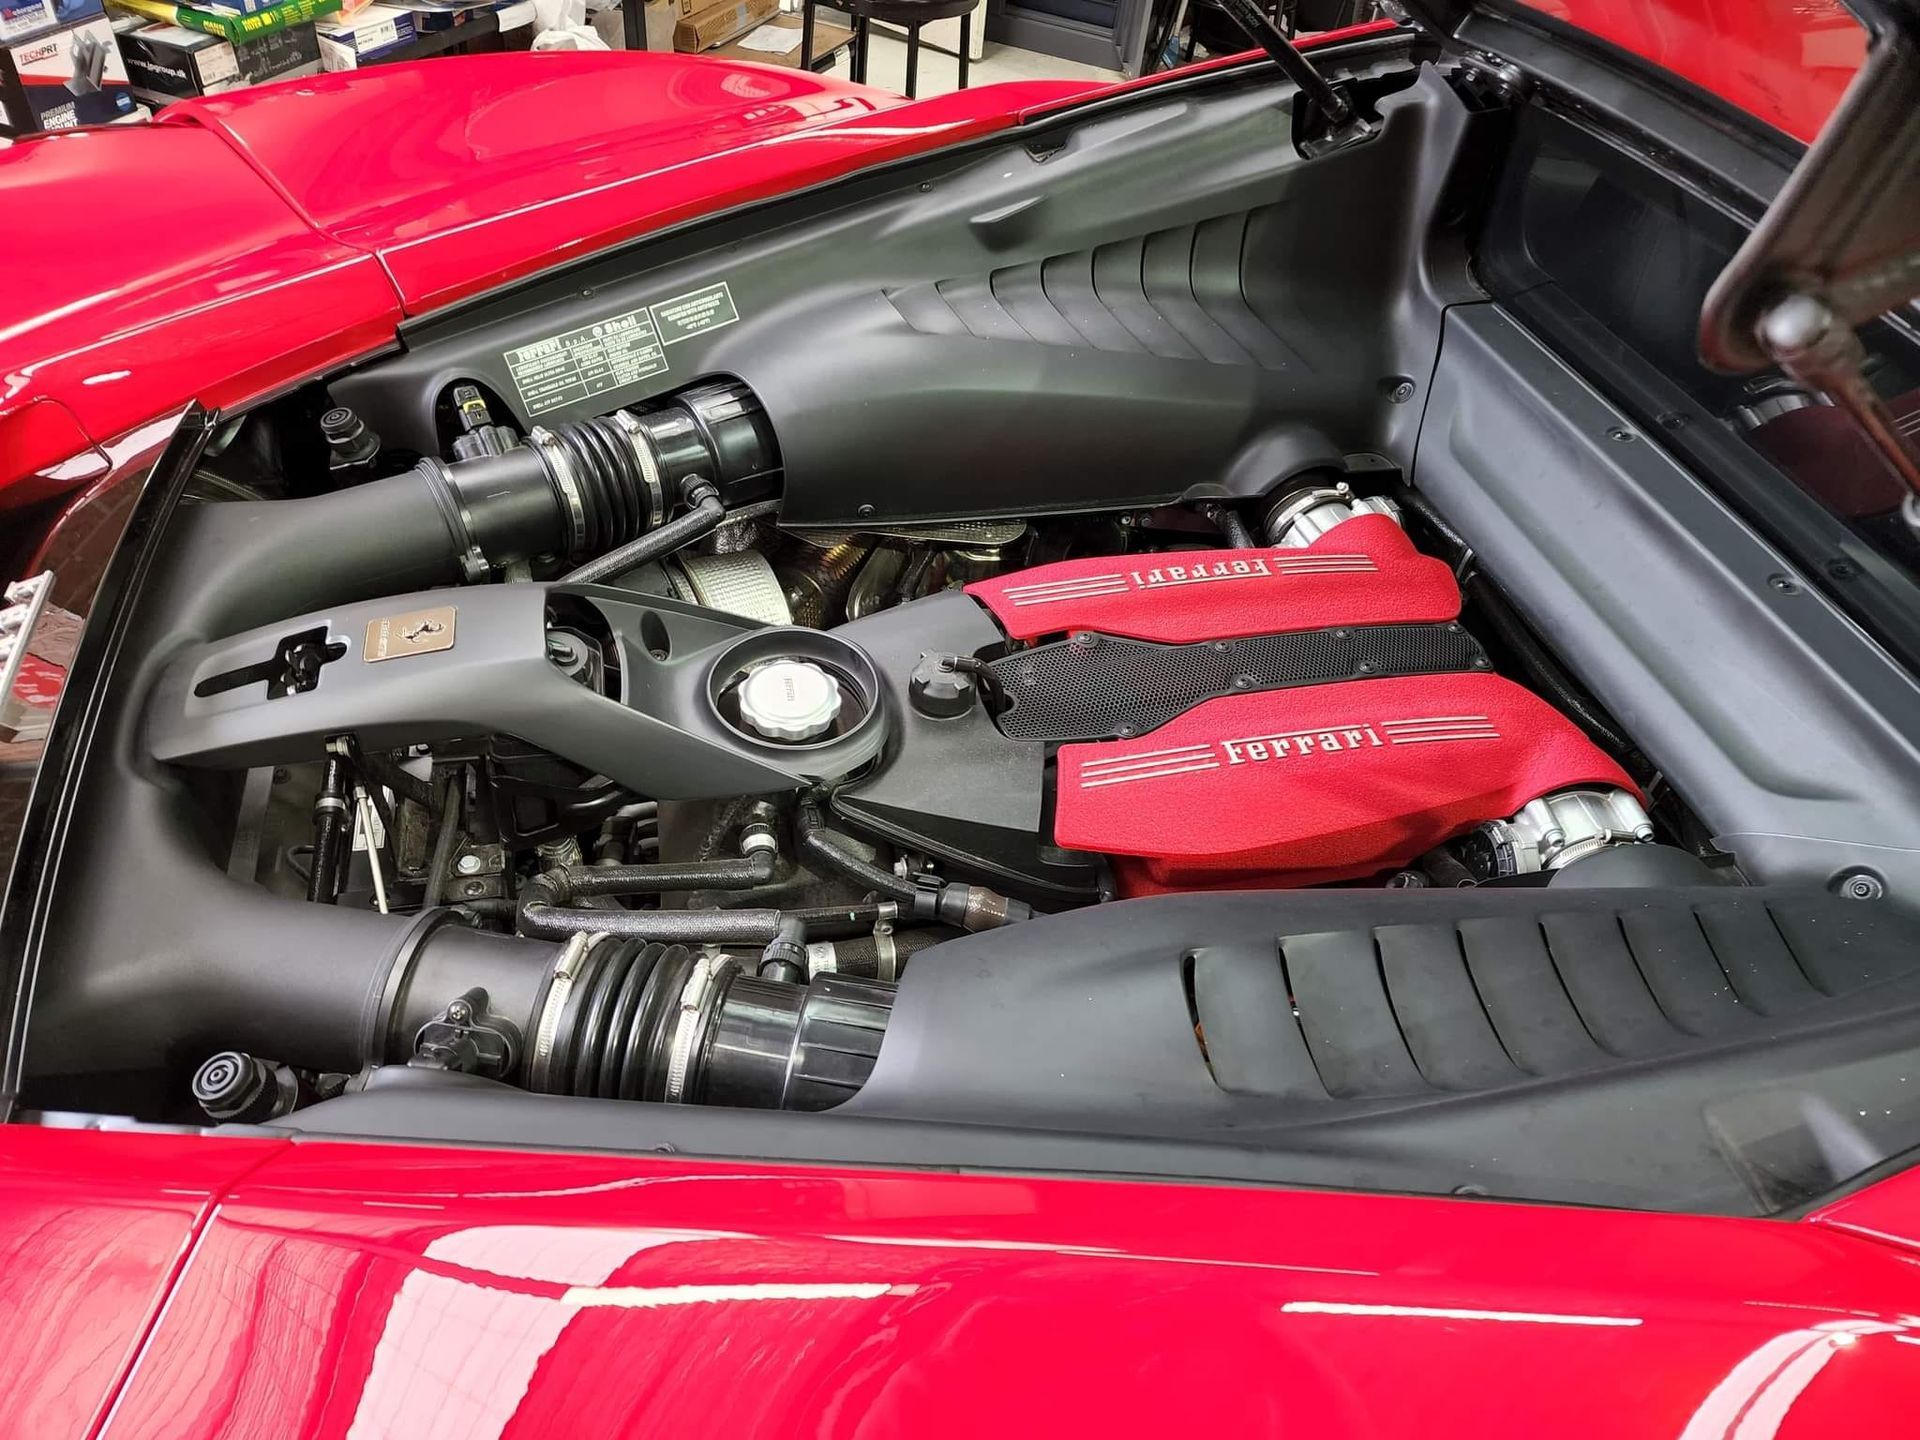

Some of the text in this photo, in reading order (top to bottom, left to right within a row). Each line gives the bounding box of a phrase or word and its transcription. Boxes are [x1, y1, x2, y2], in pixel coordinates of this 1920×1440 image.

[40, 101, 76, 121] PREMIUM
[43, 109, 76, 130] ENGINE
[604, 314, 637, 333] Shell
[1131, 558, 1272, 590] Ferrari
[1220, 724, 1383, 765] Ferrari
